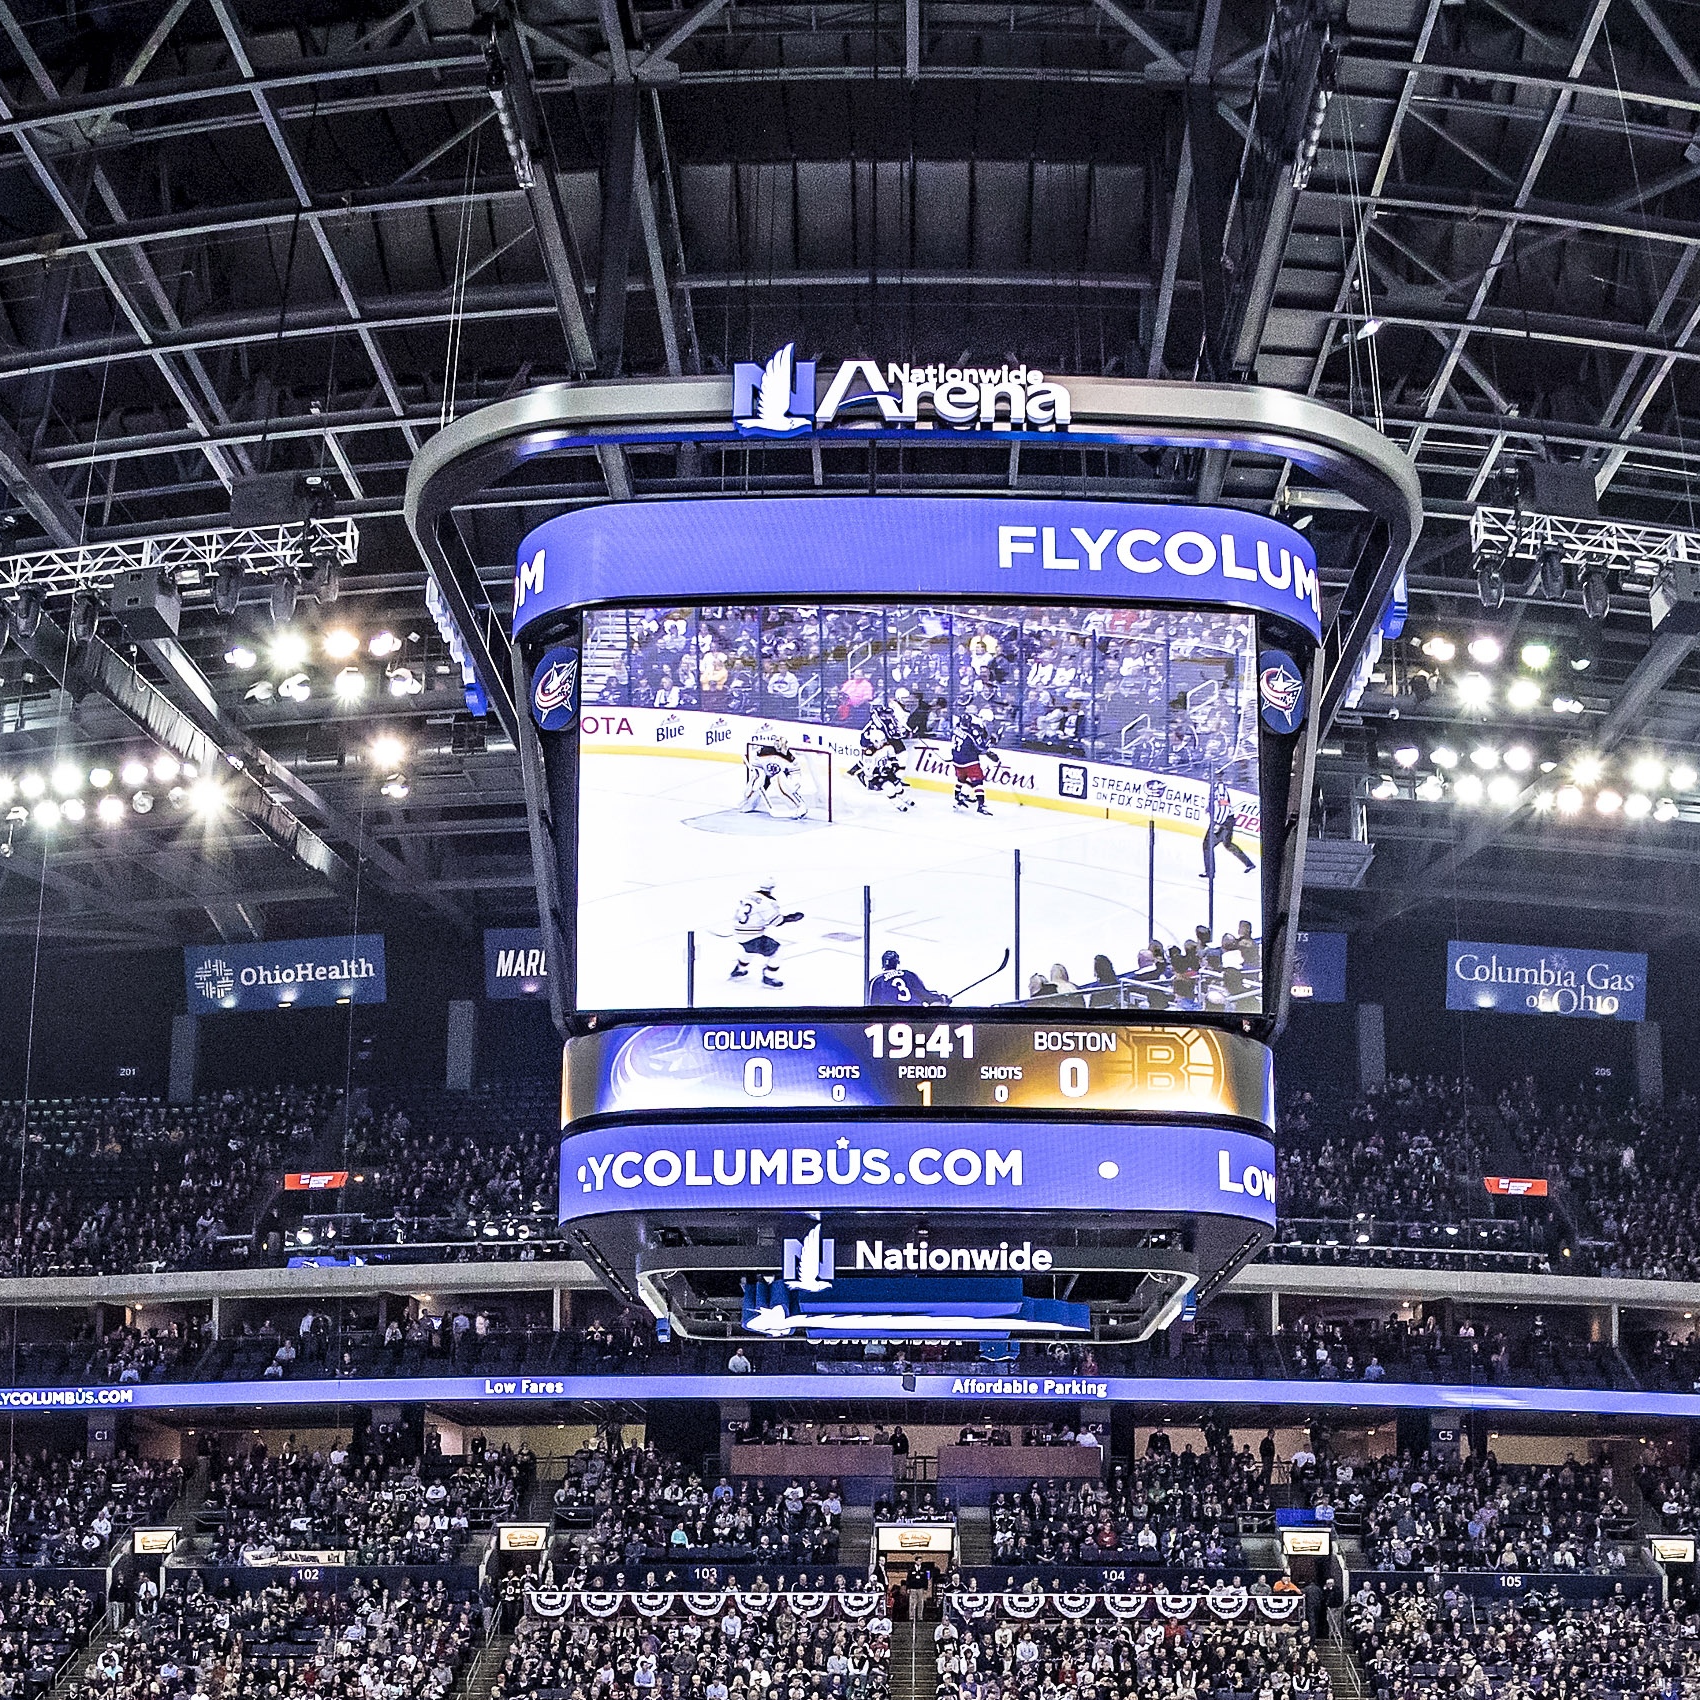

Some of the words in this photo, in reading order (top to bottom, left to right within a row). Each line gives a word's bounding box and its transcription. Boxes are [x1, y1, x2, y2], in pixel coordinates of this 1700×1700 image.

[887, 362, 1044, 385] Nationwide
[815, 359, 1073, 425] Arena
[656, 723, 685, 743] Blue
[705, 727, 733, 746] Blue
[1092, 776, 1142, 796] STREAM
[1166, 788, 1206, 810] GAMES
[1109, 793, 1135, 807] FOX
[1136, 798, 1183, 819] SPORTS
[1184, 808, 1201, 821] GO
[240, 958, 376, 985] OhioHealth
[1454, 954, 1576, 988] Columbia
[1587, 963, 1635, 992] Gas
[892, 978, 911, 1001] 3
[1526, 988, 1547, 1009] of
[1552, 985, 1619, 1015] Ohio
[703, 1029, 816, 1052] COLUMBUS
[864, 1023, 975, 1060] 19:41
[1034, 1031, 1117, 1053] BOSTON
[743, 1057, 774, 1098] 0
[818, 1065, 861, 1080] SHOTS
[898, 1065, 947, 1080] PERIOD
[980, 1065, 1023, 1081] SHOTS
[1059, 1057, 1090, 1098] 0
[832, 1084, 846, 1103] 0
[917, 1081, 932, 1107] 1
[995, 1085, 1010, 1104] 0
[856, 1240, 1053, 1271] Nationwide
[485, 1379, 517, 1394] Low
[521, 1379, 564, 1394] Fares
[951, 1379, 1039, 1393] Affordable
[1044, 1380, 1108, 1398] Parking
[297, 1568, 320, 1581] 102
[694, 1567, 718, 1580] 103
[1102, 1570, 1126, 1582] 104
[1500, 1575, 1522, 1588] 105
